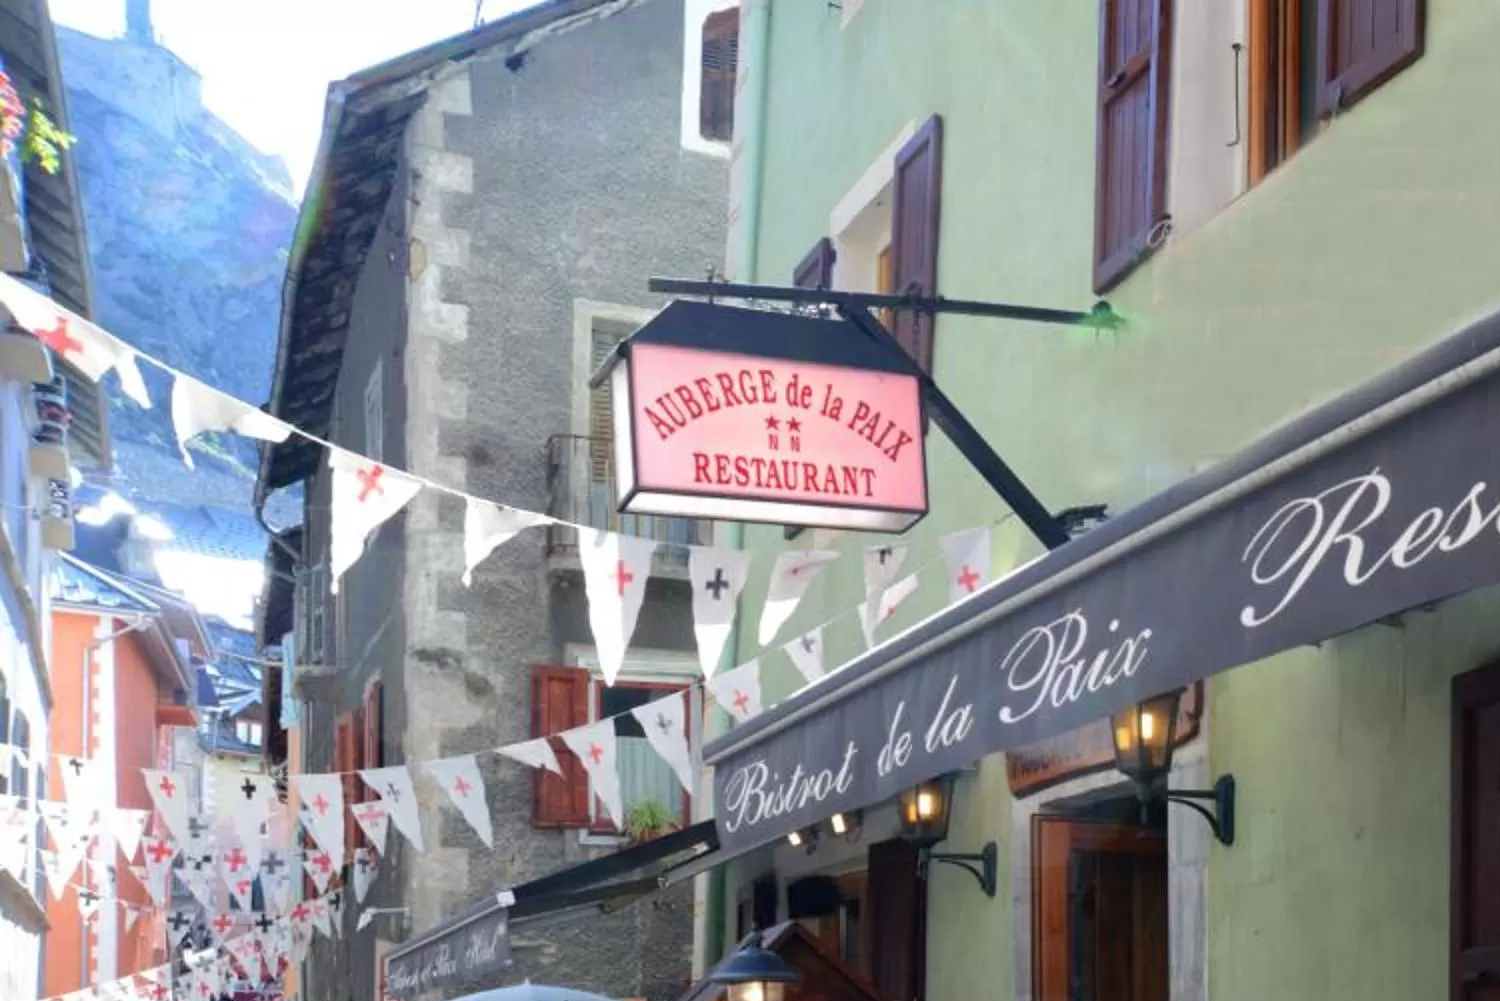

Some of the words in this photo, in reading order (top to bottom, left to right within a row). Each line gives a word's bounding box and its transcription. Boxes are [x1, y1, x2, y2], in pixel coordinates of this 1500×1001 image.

[644, 369, 777, 441] AUBERGE
[786, 374, 813, 410] de
[819, 384, 843, 422] la
[848, 400, 913, 463] PAIX
[693, 452, 877, 498] RESTAURANT
[725, 740, 859, 833] Bistrot
[877, 700, 913, 777] de
[925, 674, 975, 754] la
[999, 608, 1153, 724] Paix
